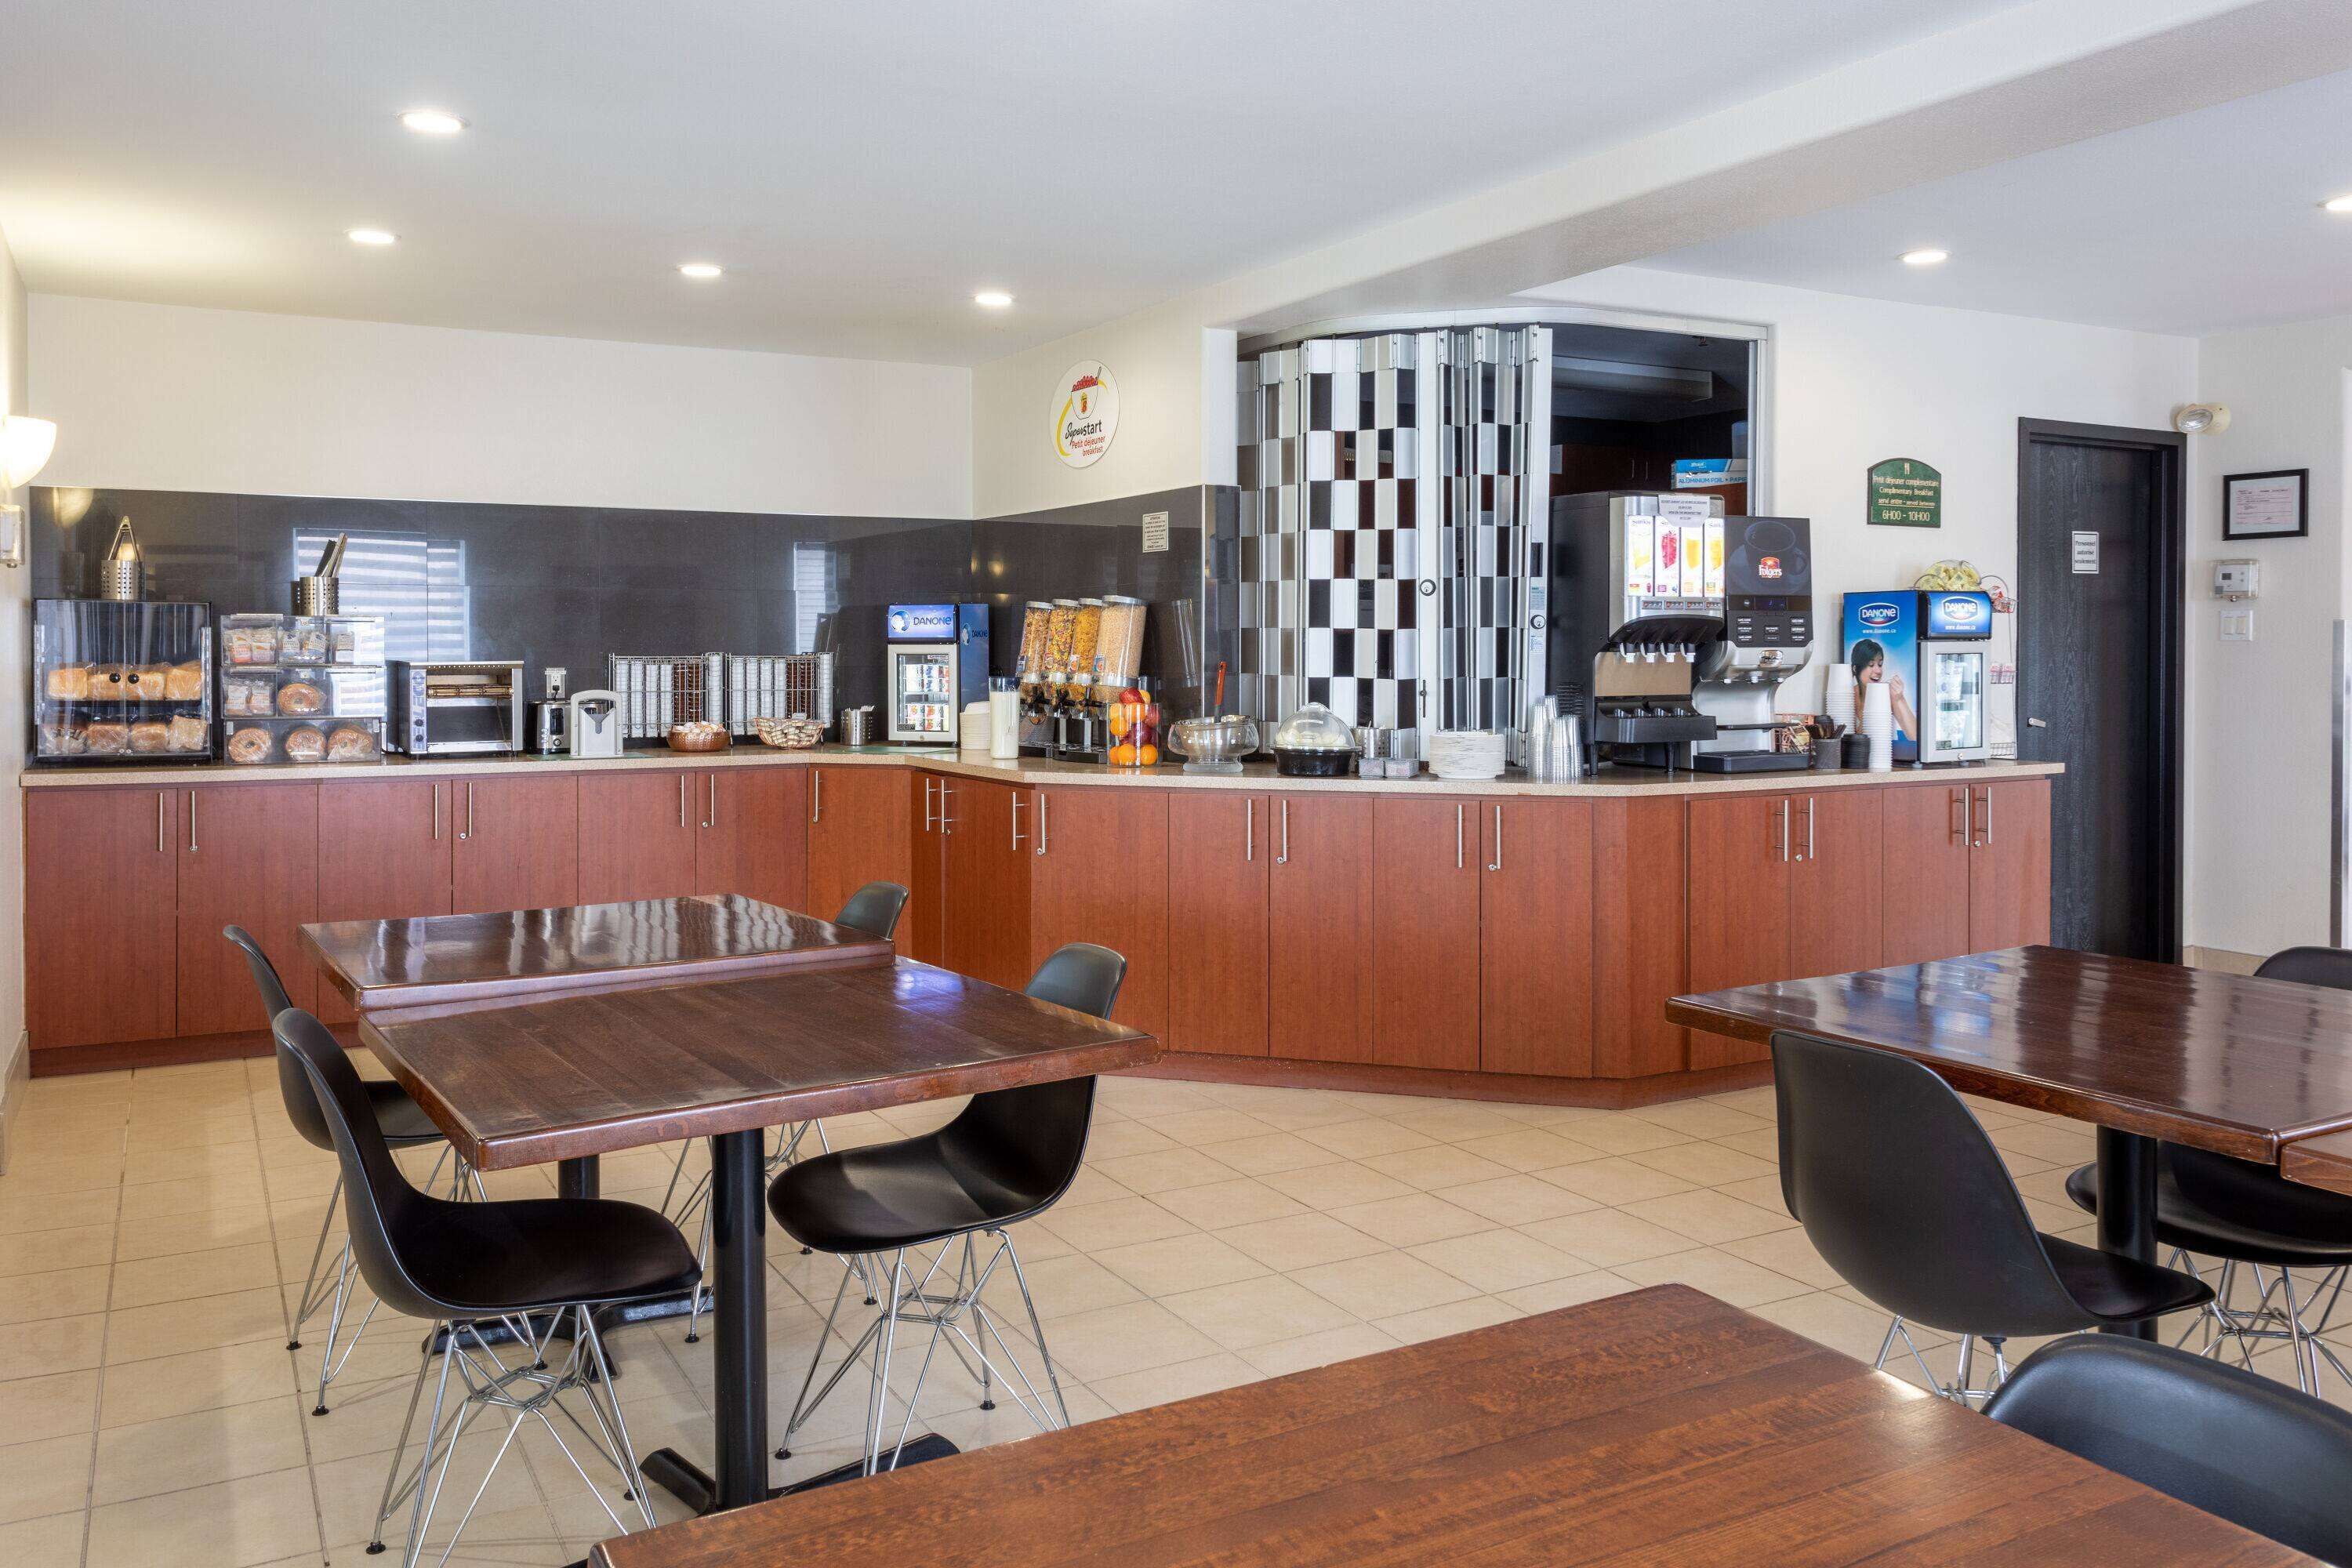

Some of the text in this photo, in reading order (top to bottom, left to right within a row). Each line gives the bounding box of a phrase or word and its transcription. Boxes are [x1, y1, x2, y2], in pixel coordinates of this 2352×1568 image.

[1072, 440, 1083, 450] Petit
[1082, 446, 1104, 457] breakfast
[1882, 510, 1901, 520] 6H00
[1908, 511, 1929, 521] 10H00
[1758, 564, 1783, 579] Folgers
